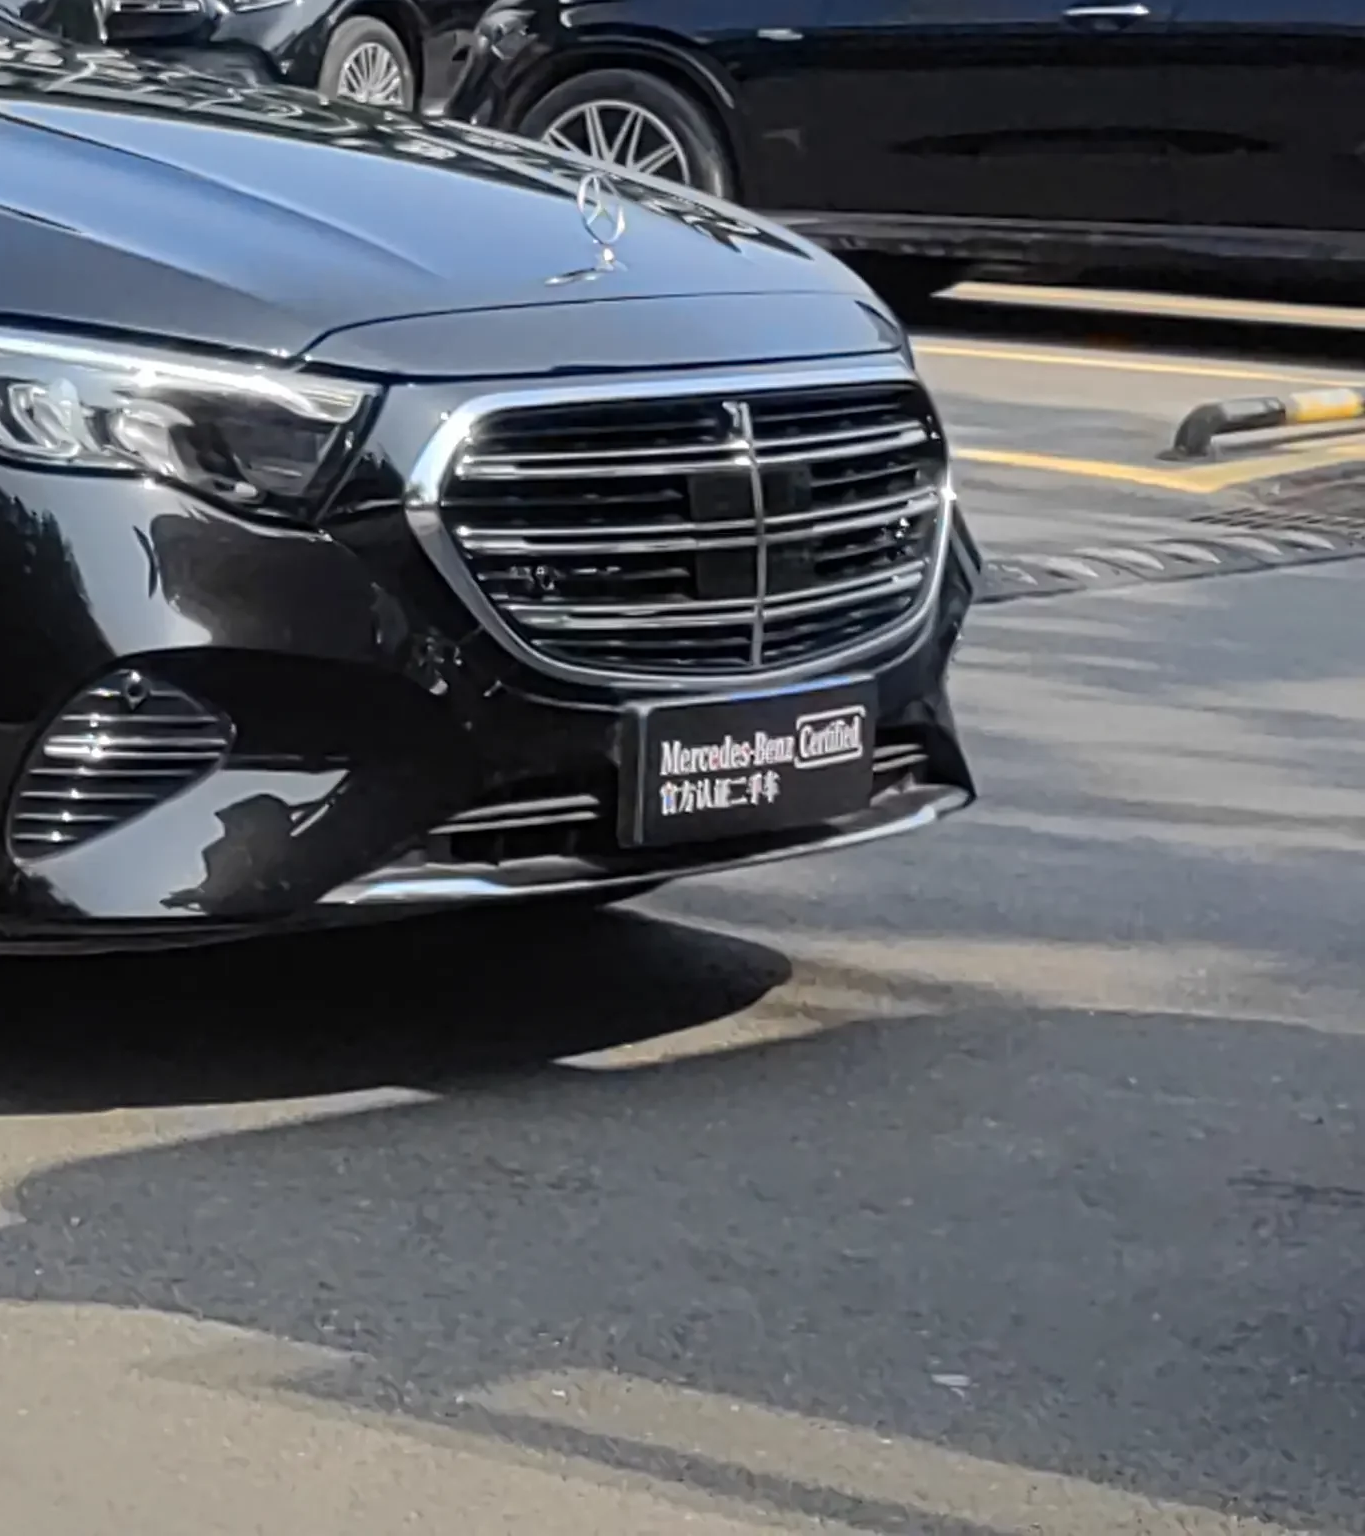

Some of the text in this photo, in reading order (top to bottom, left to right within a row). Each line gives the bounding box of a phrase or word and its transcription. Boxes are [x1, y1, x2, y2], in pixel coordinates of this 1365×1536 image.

[660, 715, 861, 776] Mercedes-Benz Certified
[659, 769, 781, 816] 官方认证二手车
